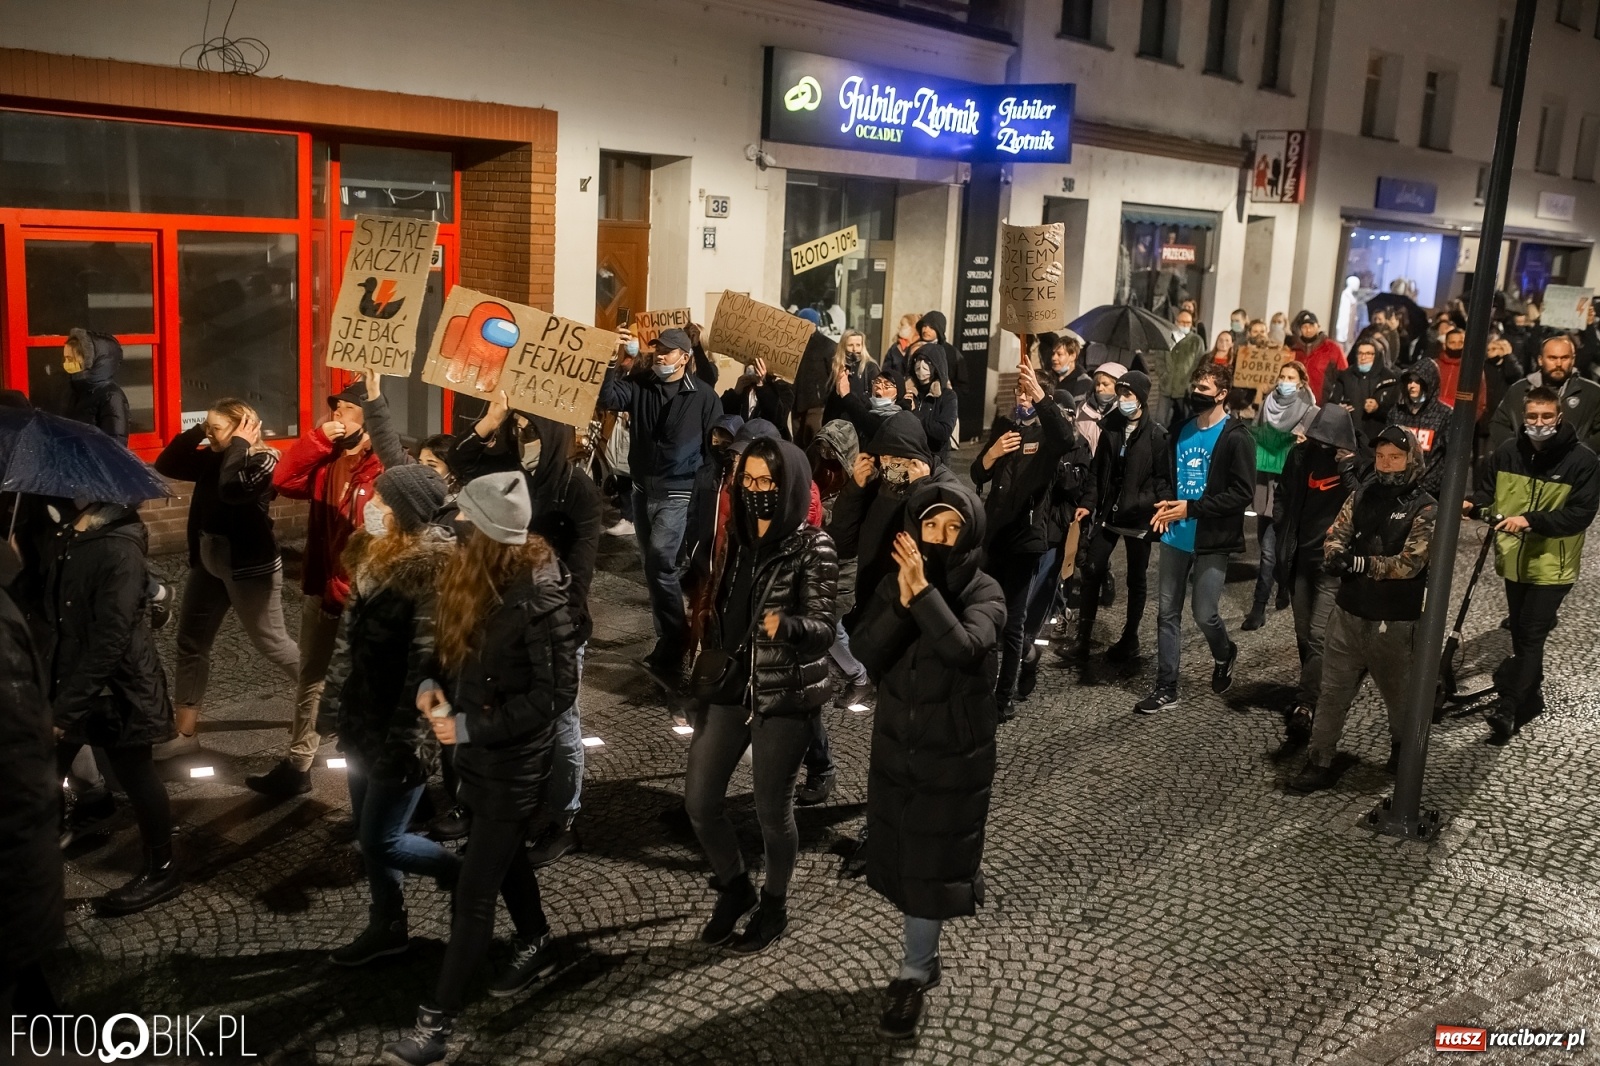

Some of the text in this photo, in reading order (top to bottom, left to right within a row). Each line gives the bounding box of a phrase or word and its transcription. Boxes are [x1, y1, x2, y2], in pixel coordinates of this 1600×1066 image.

[838, 76, 979, 138] Jubiler Złotnik
[998, 97, 1056, 127] Jubiler
[996, 127, 1055, 154] Złotnik
[712, 200, 728, 213] 36
[357, 218, 430, 250] STARE
[705, 234, 714, 245] 36
[350, 247, 421, 274] KACZKI
[794, 230, 857, 270] ZŁOTO -10%
[338, 314, 408, 344] JEBAĆ
[721, 291, 810, 338] MOIM CIAŁEM
[540, 316, 586, 351] PIS
[331, 340, 410, 370] PRĄDEM
[518, 342, 606, 385] FEJKUJE
[1186, 458, 1203, 468] 4F
